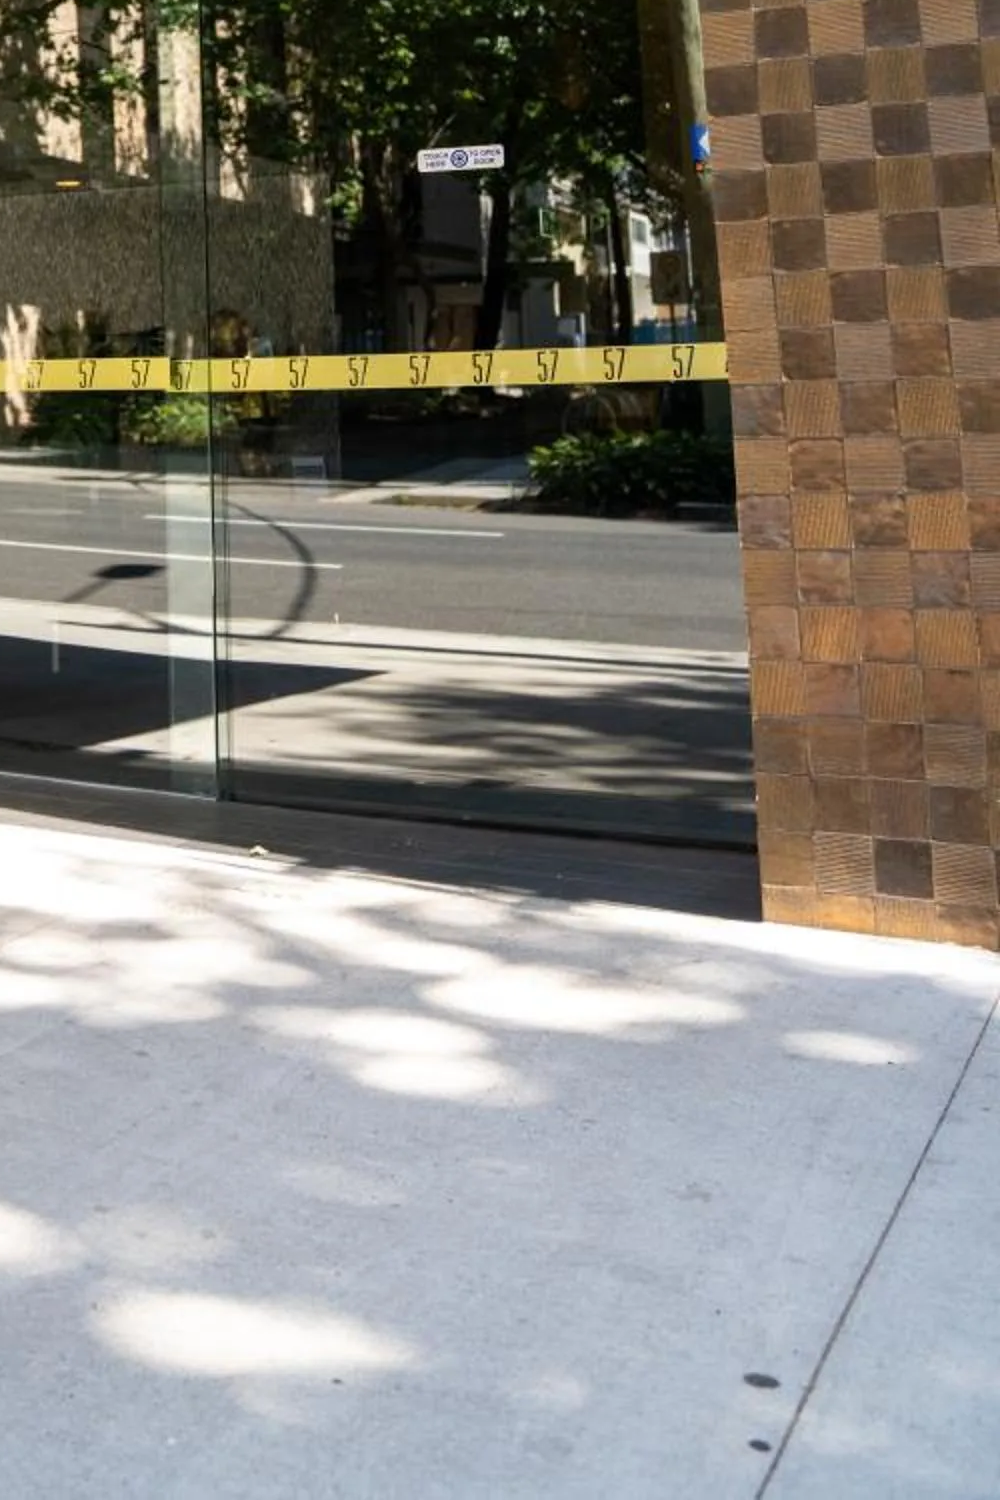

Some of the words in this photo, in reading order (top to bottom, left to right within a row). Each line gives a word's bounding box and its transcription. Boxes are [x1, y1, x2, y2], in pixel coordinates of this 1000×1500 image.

[26, 361, 44, 389] 57
[78, 360, 96, 388] 57
[131, 360, 149, 388] 57
[174, 362, 192, 389] 57
[231, 360, 250, 389] 57
[289, 358, 309, 388] 57
[349, 357, 368, 386] 57
[409, 356, 431, 385] 57
[472, 354, 493, 384] 57
[537, 351, 559, 382] 57
[603, 348, 625, 380] 57
[671, 346, 694, 378] 57
